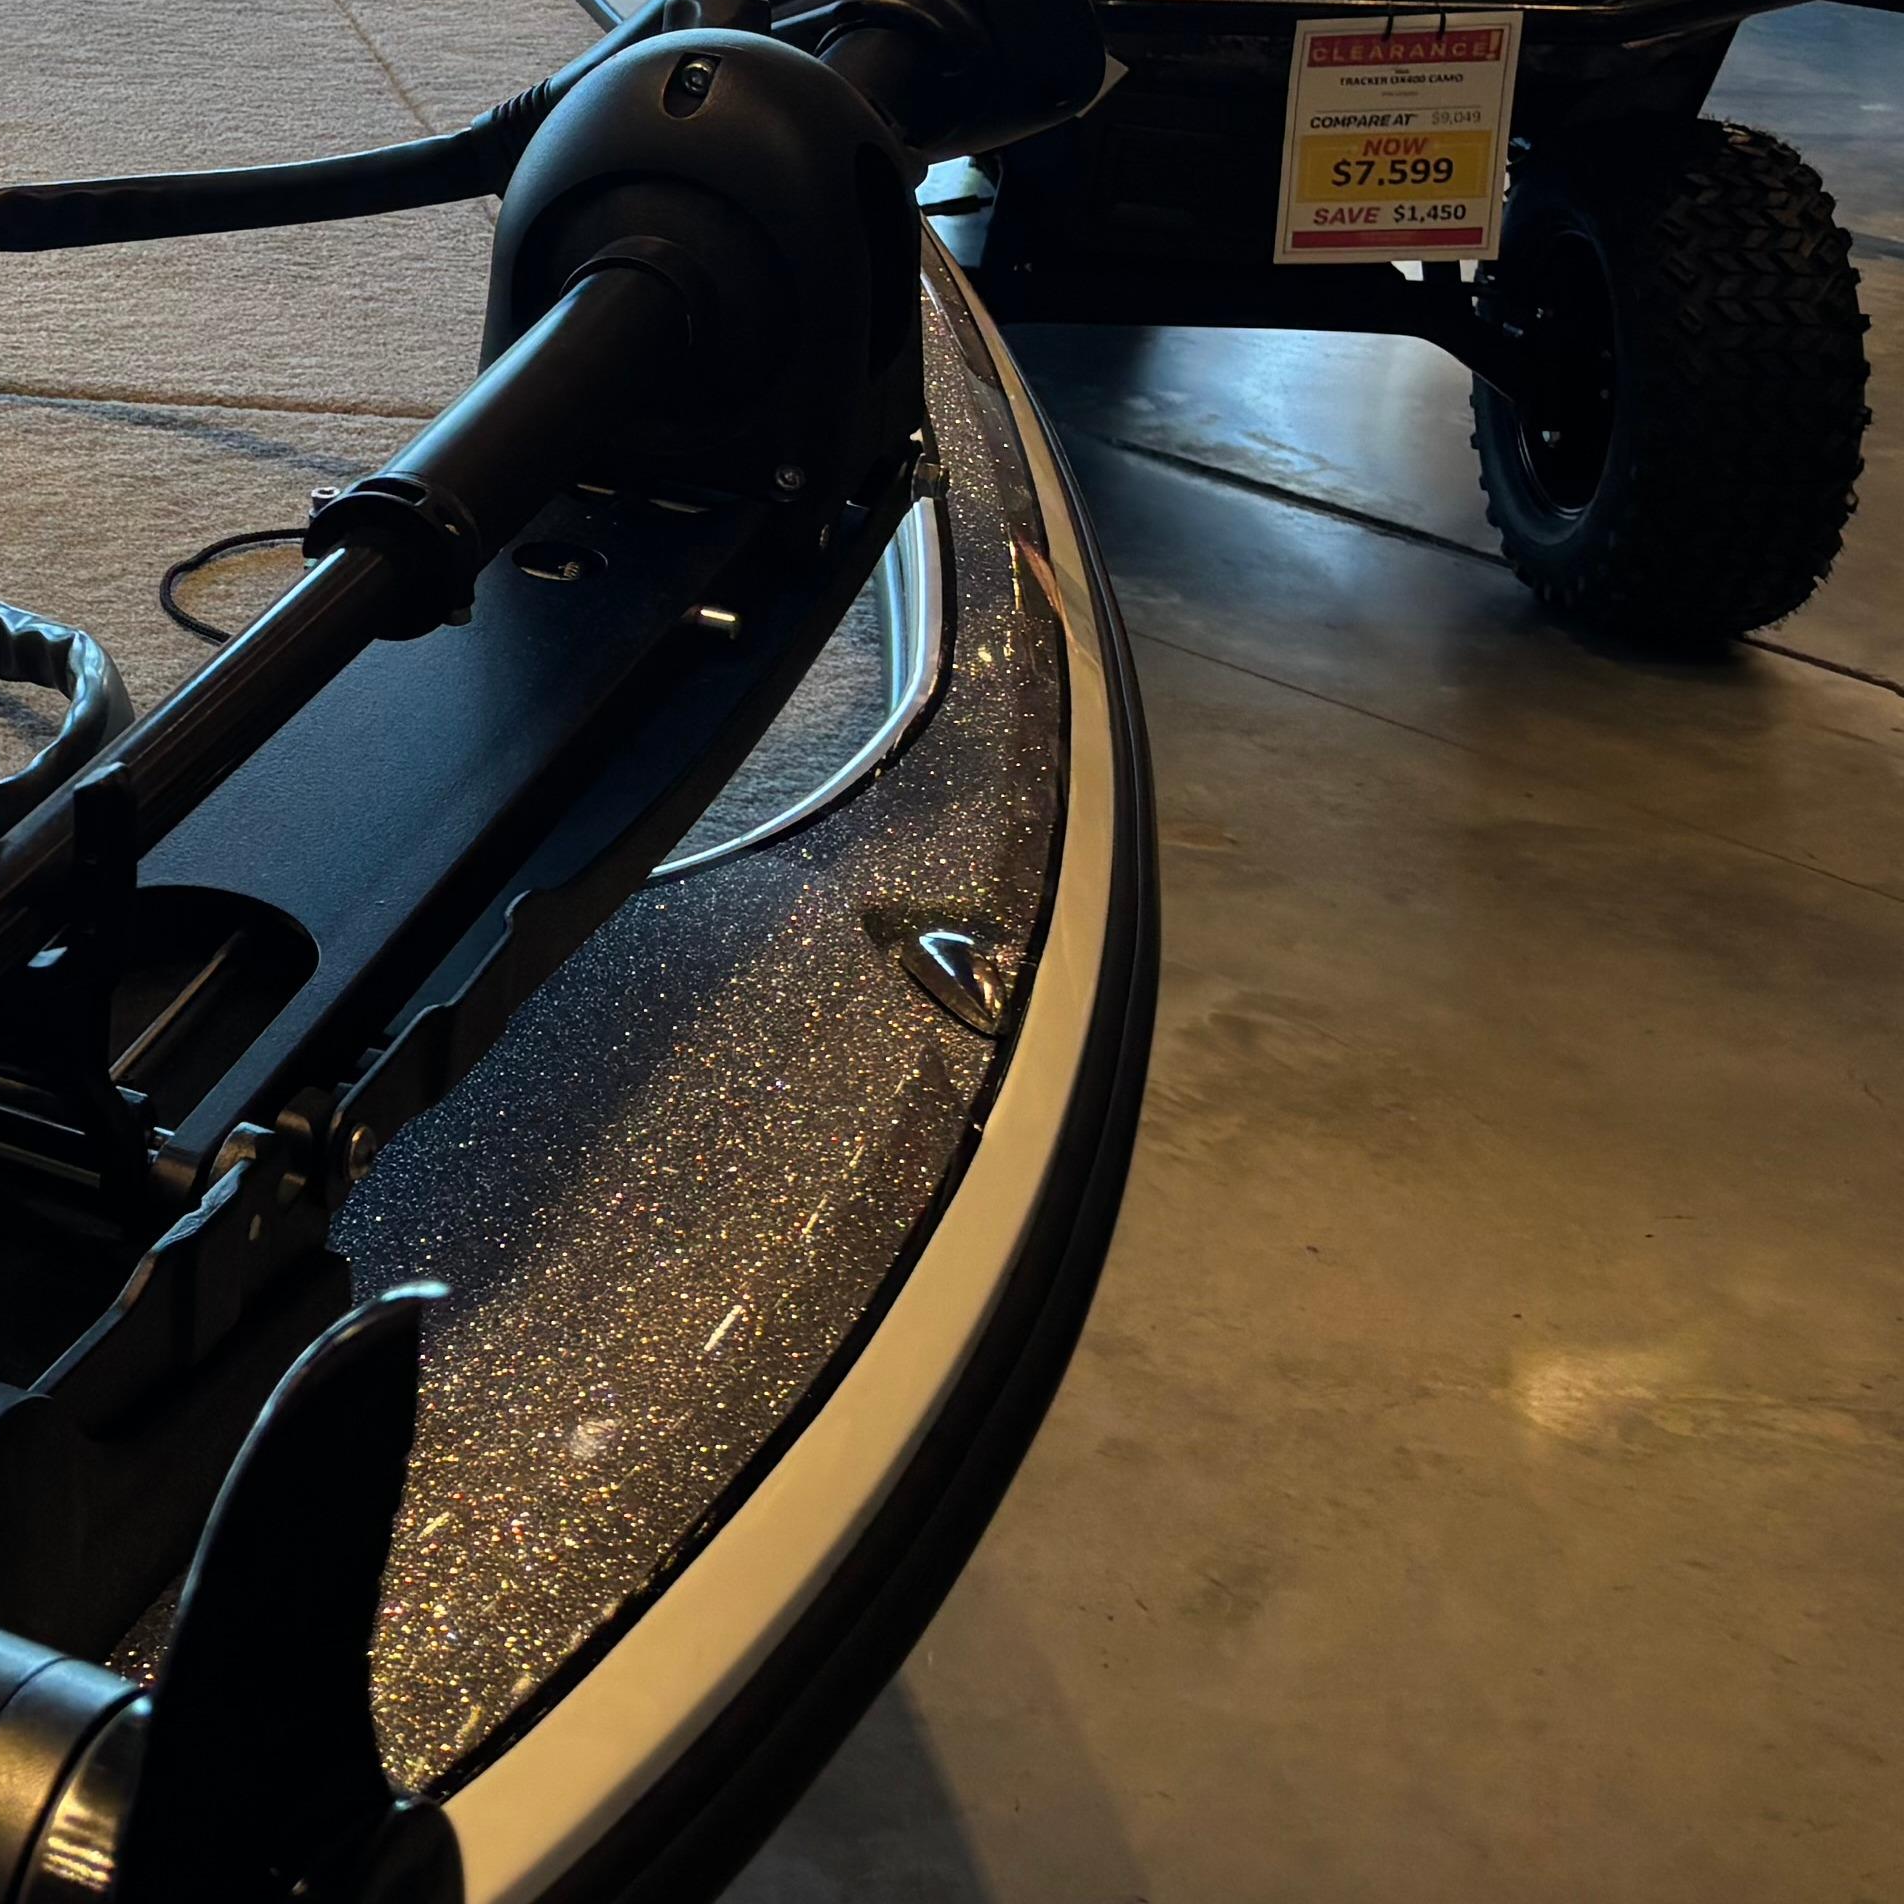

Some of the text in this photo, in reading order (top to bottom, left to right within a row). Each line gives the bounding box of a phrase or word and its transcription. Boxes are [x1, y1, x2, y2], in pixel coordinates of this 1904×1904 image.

[1340, 76, 1388, 86] TRACKER
[1428, 73, 1464, 84] CAMO
[1310, 114, 1391, 129] COMPARE
[1432, 110, 1482, 126] $9,049
[1363, 137, 1429, 157] NOW
[1313, 204, 1466, 226] SAVE $1,450
